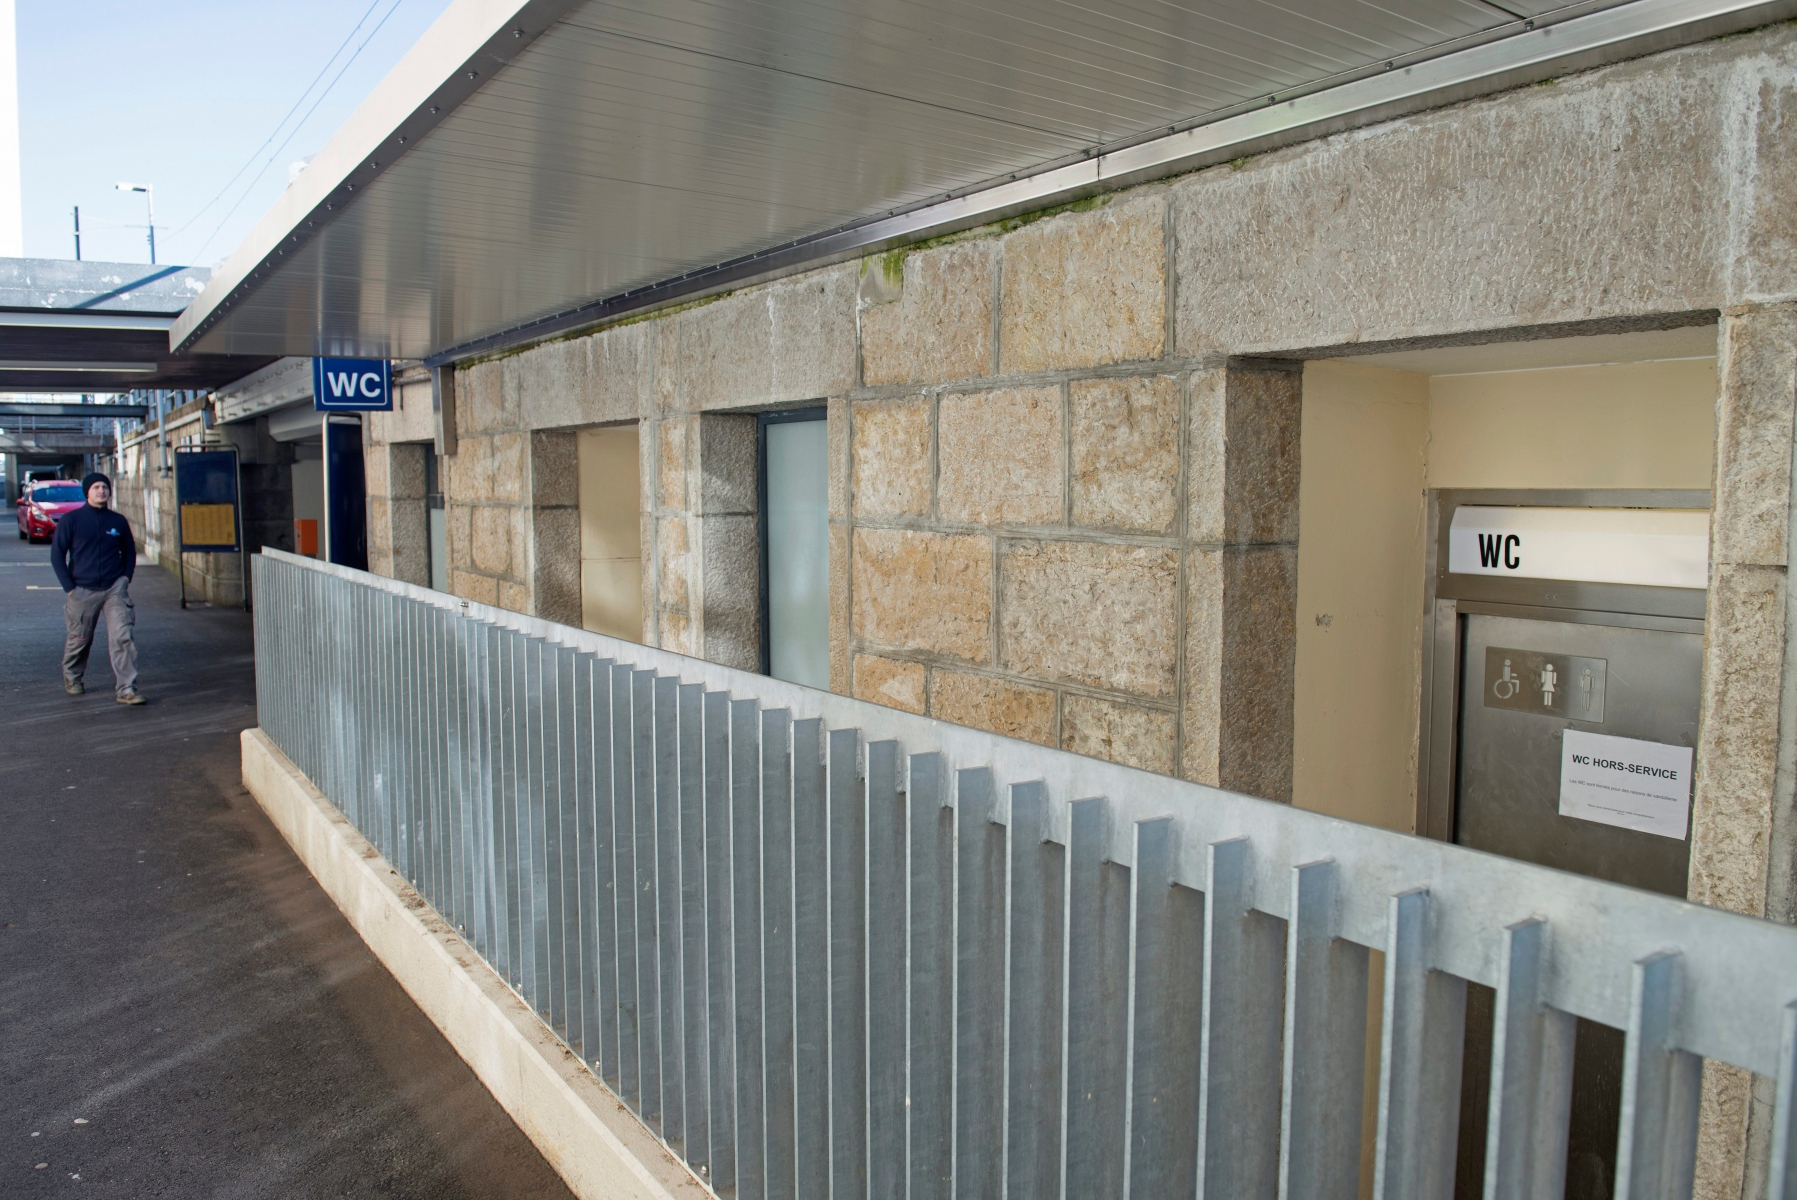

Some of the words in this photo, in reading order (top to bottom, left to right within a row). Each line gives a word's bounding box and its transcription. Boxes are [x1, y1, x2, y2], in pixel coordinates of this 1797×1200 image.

[327, 371, 381, 398] WC
[1478, 533, 1521, 570] WC
[1572, 754, 1590, 765] WC
[1593, 757, 1678, 780] HORS-SERVICE
